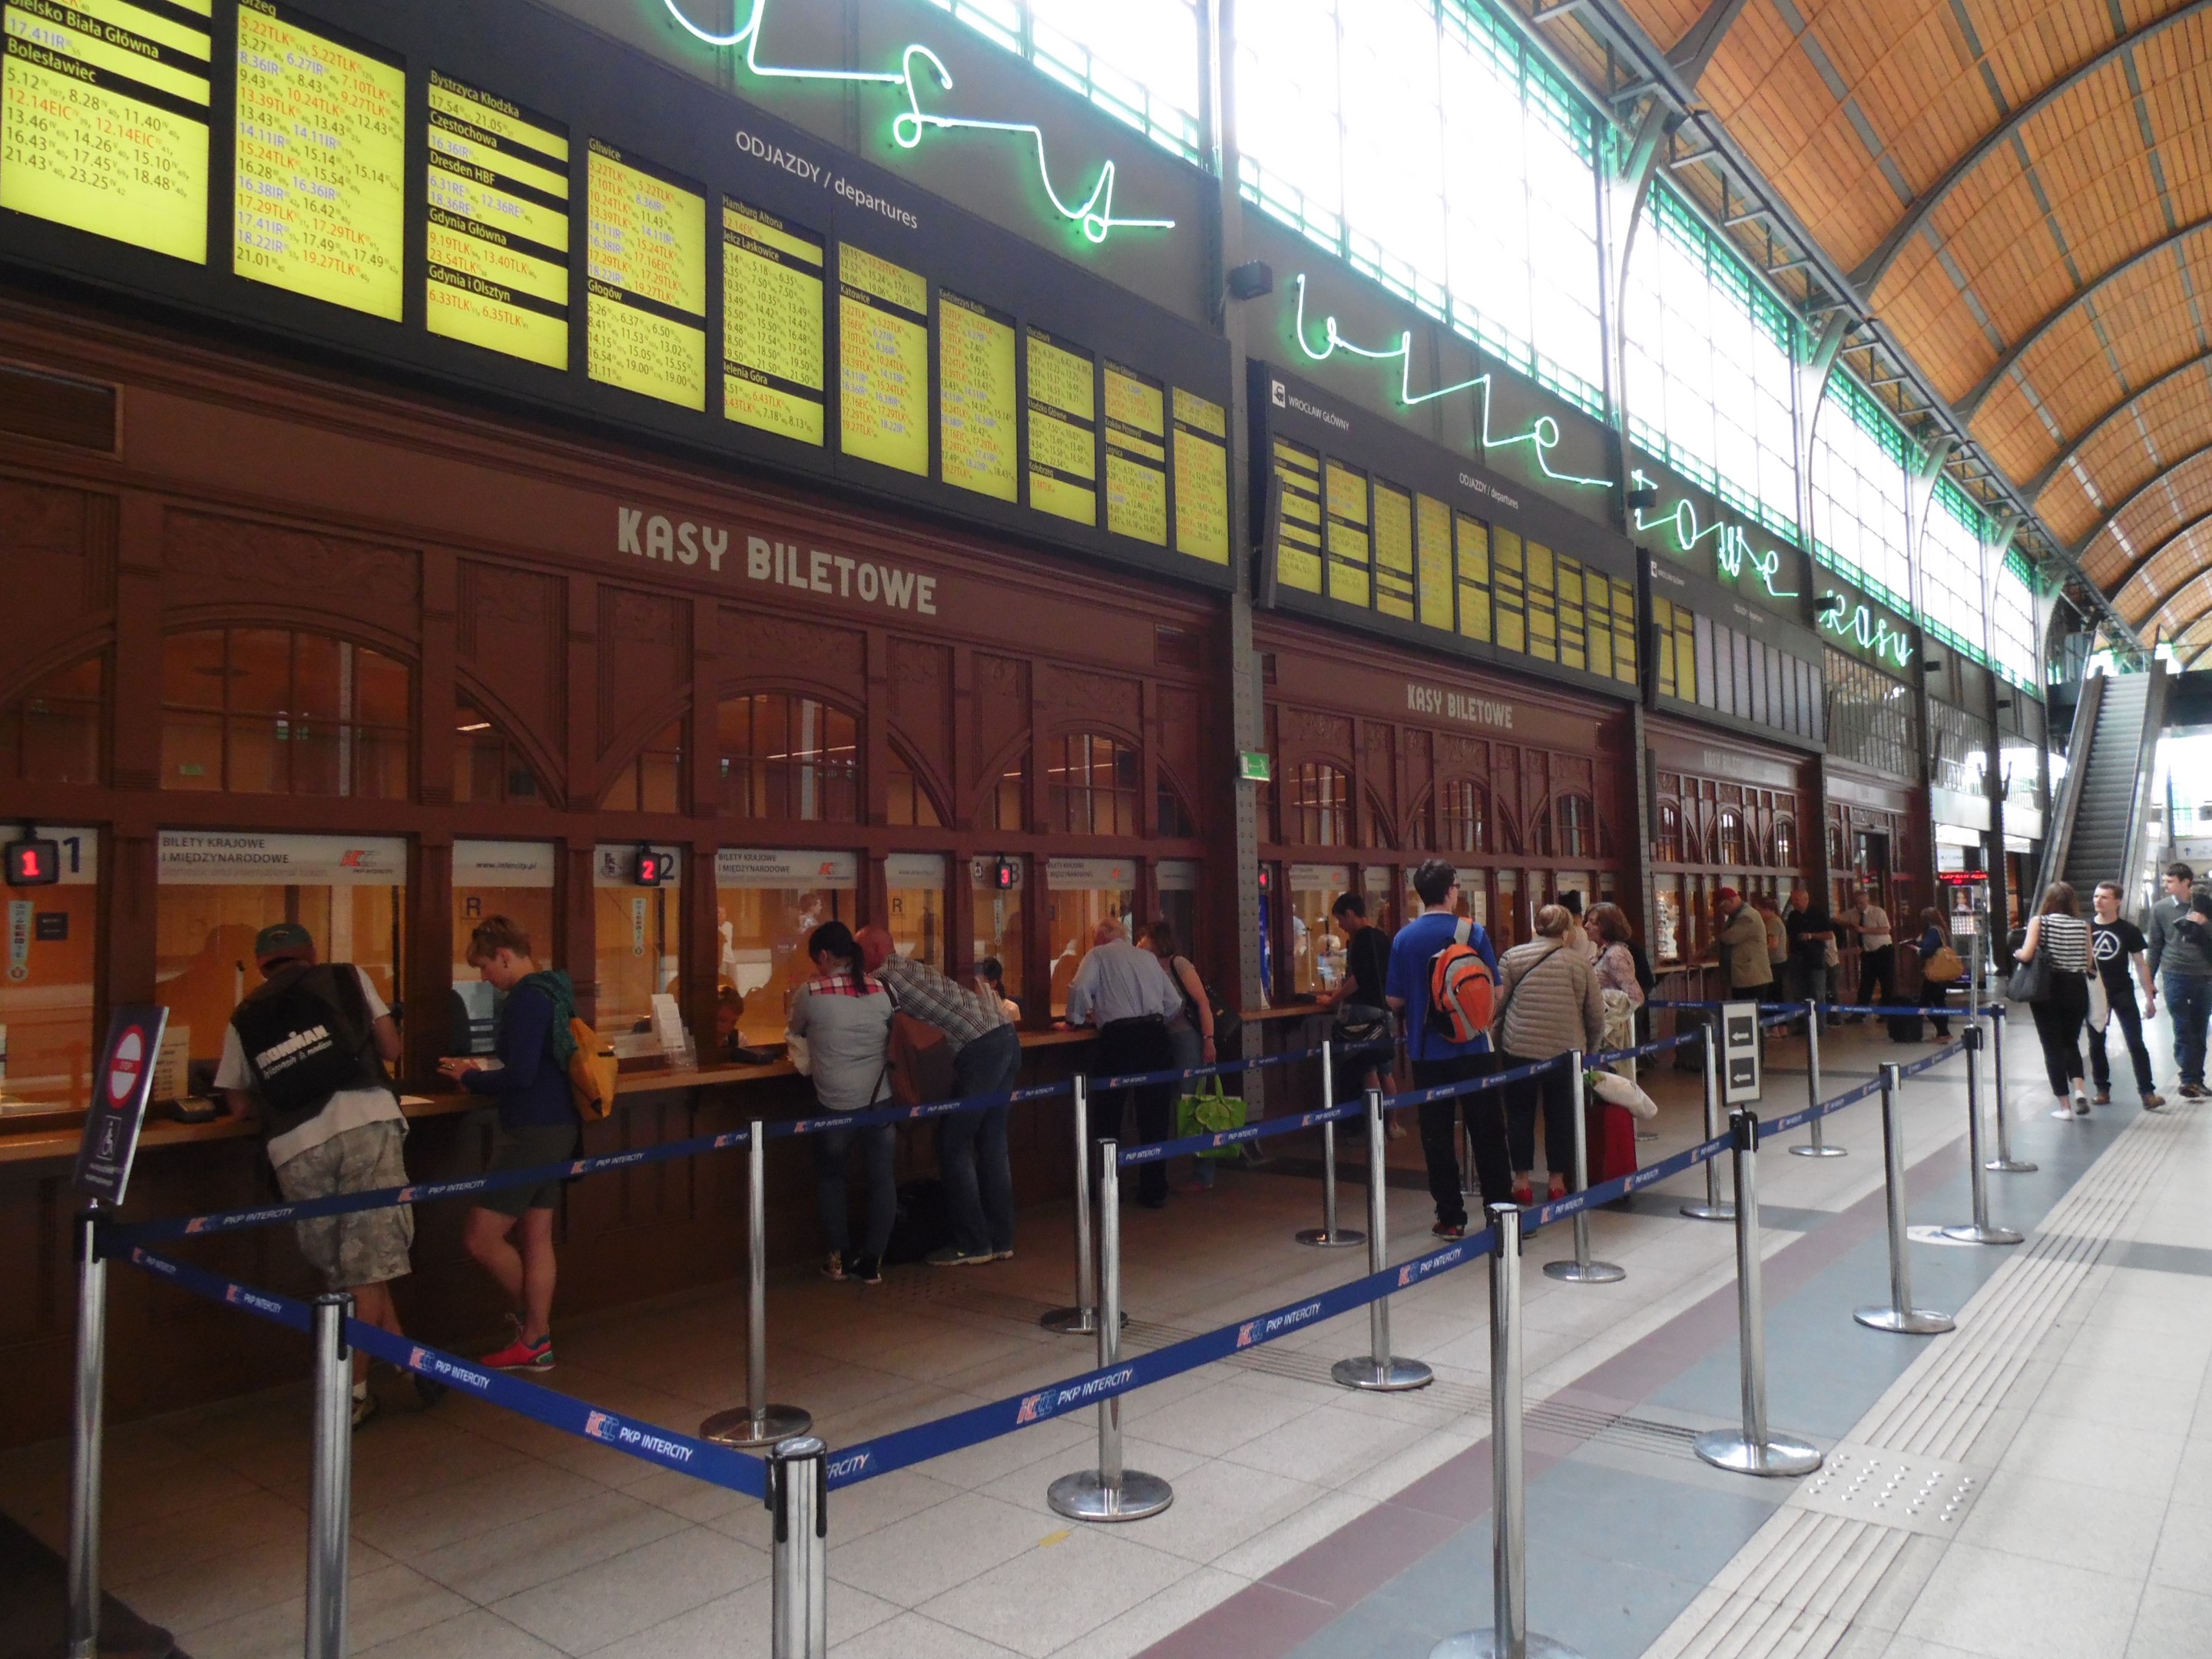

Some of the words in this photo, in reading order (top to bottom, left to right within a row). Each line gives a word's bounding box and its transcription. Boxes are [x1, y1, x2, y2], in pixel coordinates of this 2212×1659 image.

[66, 11, 101, 37] Biała
[105, 26, 159, 58] Główna
[8, 38, 96, 82] Bolesławiec
[430, 110, 496, 150] Częstochowa
[430, 150, 472, 177] Dresden
[475, 167, 494, 186] HBF
[736, 131, 821, 187] ODJAZDY
[835, 177, 918, 228] departures
[429, 208, 465, 234] Gdynia
[468, 221, 506, 248] Główna
[429, 264, 465, 290] Gdynia
[468, 276, 471, 292] i
[473, 278, 509, 304] Olsztyn
[1459, 472, 1487, 494] ODJAZDY
[618, 506, 728, 571] KASY
[747, 535, 937, 615] BILETOWE
[1407, 684, 1442, 715] KASY
[1447, 692, 1513, 729] BILETOWE
[63, 836, 80, 873] 1
[163, 836, 204, 848] BILETY
[208, 838, 265, 849] KRAJOWE
[642, 861, 655, 879] 2
[1001, 868, 1010, 884] 3
[466, 896, 482, 916] R
[428, 1185, 444, 1195] PKP
[446, 1179, 487, 1192] INTERCITY
[223, 1214, 246, 1225] PKP
[1420, 1261, 1432, 1275] PKP
[1433, 1249, 1462, 1270] INTERCITY
[243, 1293, 255, 1305] PKP
[255, 1296, 283, 1314] INTERCITY
[1266, 1316, 1283, 1333] PKP
[1284, 1303, 1321, 1326] INTERCITY
[435, 1360, 451, 1374] PKP
[452, 1365, 490, 1390] INTERCITY
[1058, 1386, 1080, 1406] PKP
[1081, 1368, 1133, 1397] INTERCITY
[619, 1427, 641, 1445] PKP
[641, 1432, 693, 1462] INTERCITY
